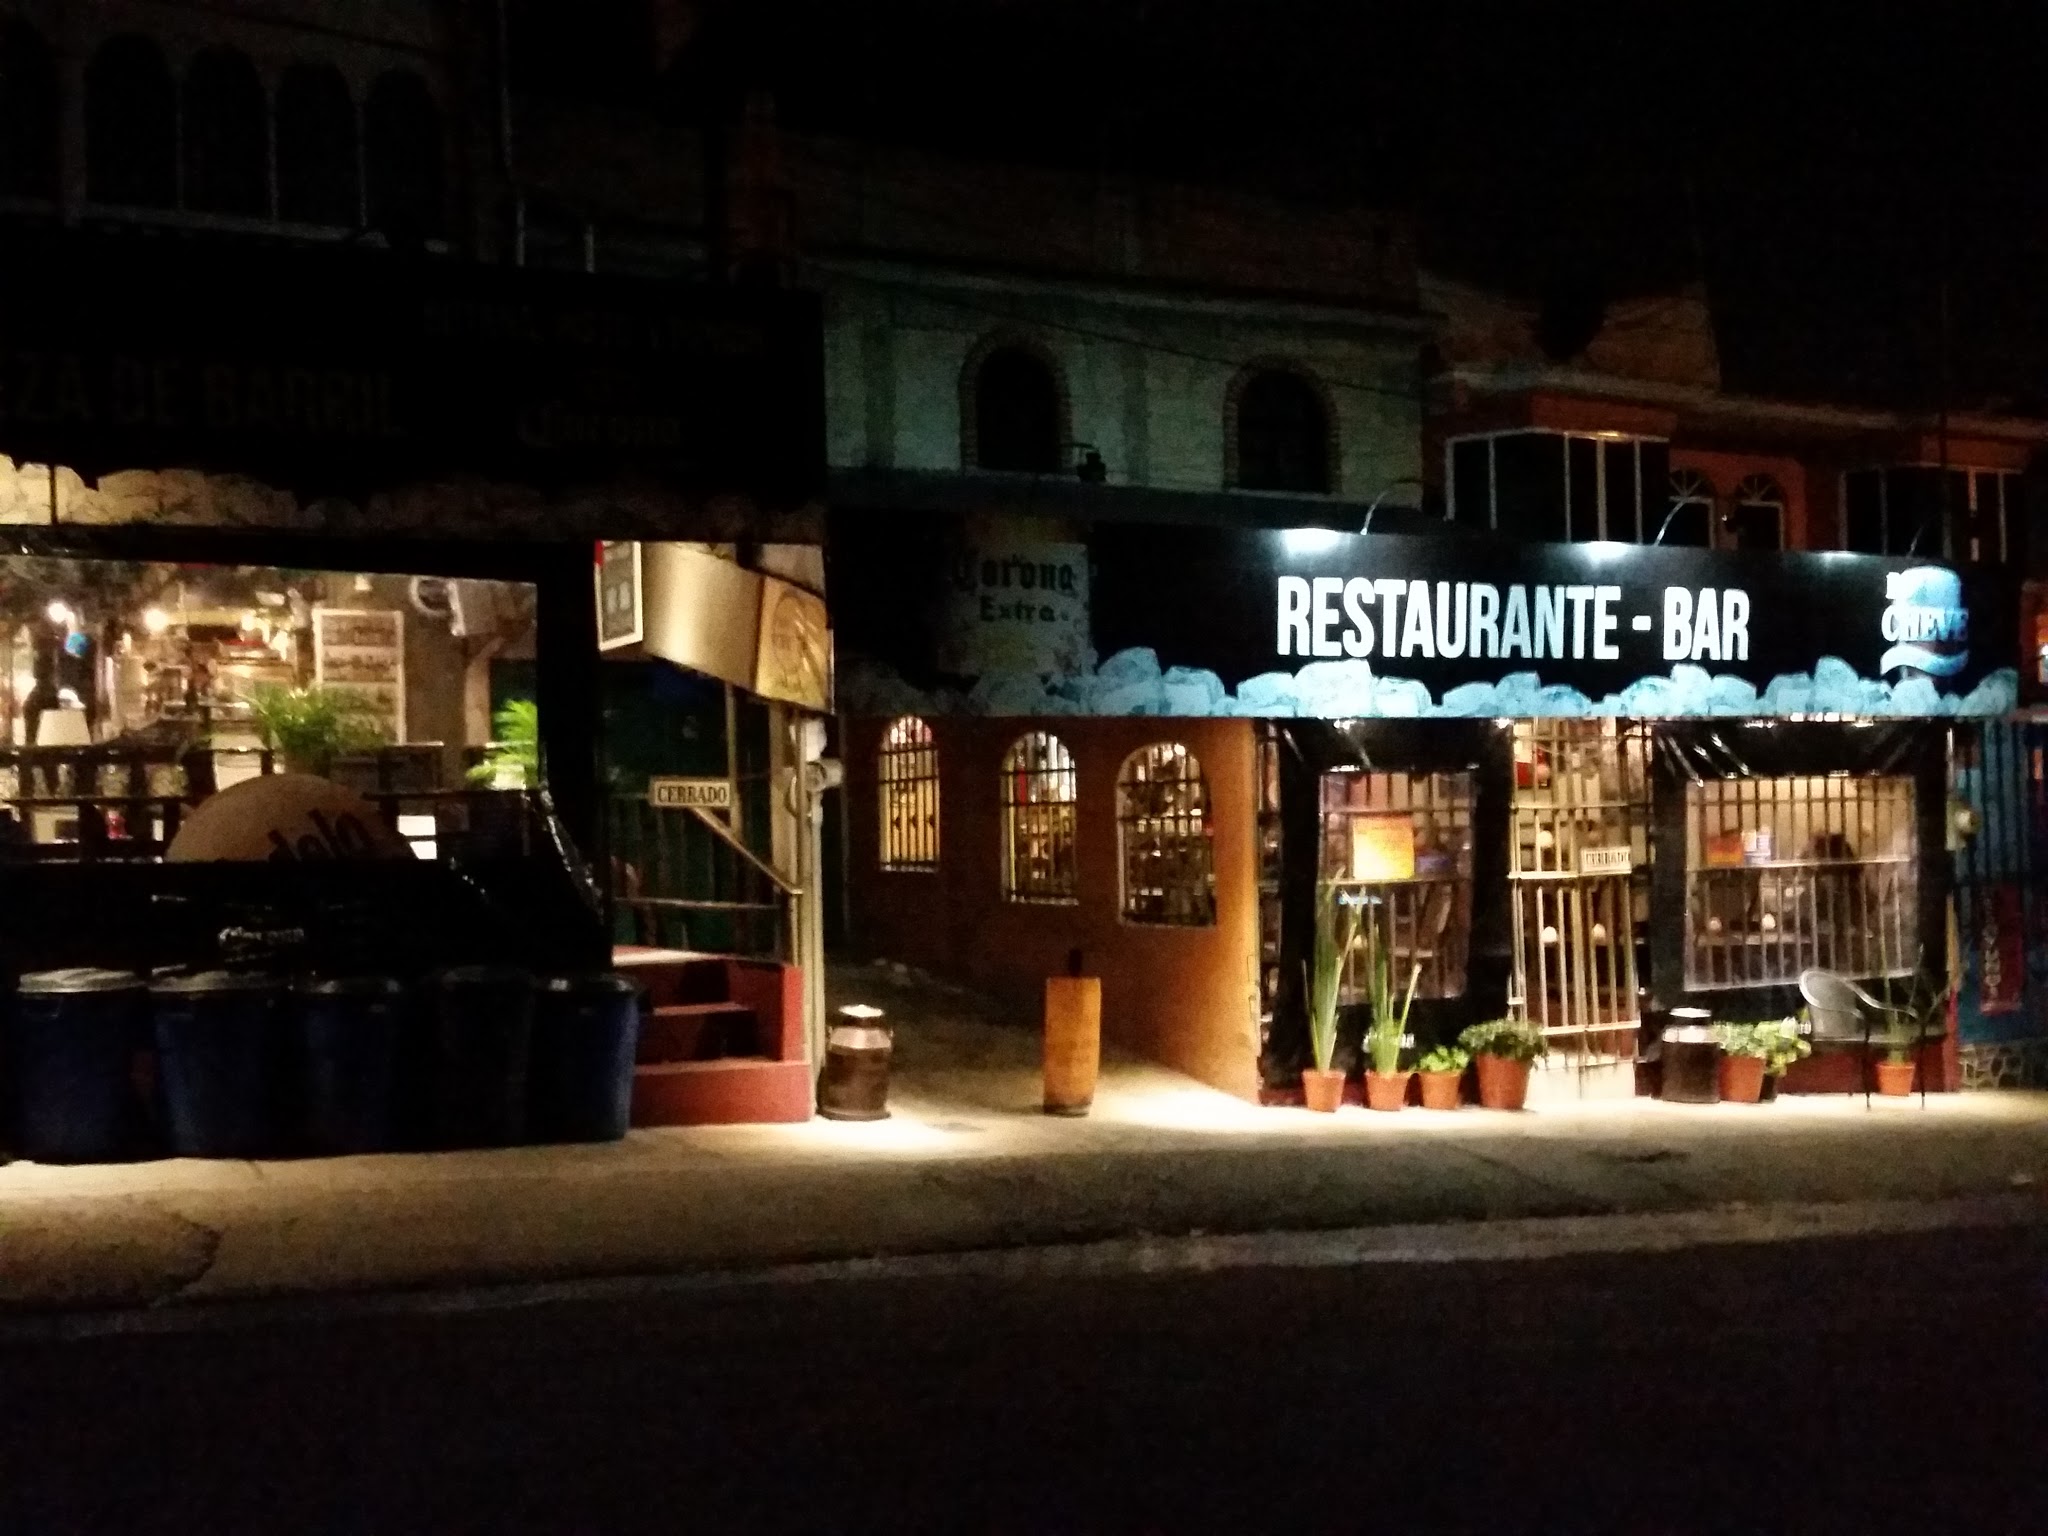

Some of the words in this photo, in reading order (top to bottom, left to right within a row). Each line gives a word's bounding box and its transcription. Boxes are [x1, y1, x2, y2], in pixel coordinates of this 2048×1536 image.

[112, 353, 180, 427] DE
[952, 554, 1078, 598] Corona
[1277, 575, 1621, 660] RESTAURANTE
[1663, 586, 1749, 660] BAR
[658, 786, 727, 804] CERRADO
